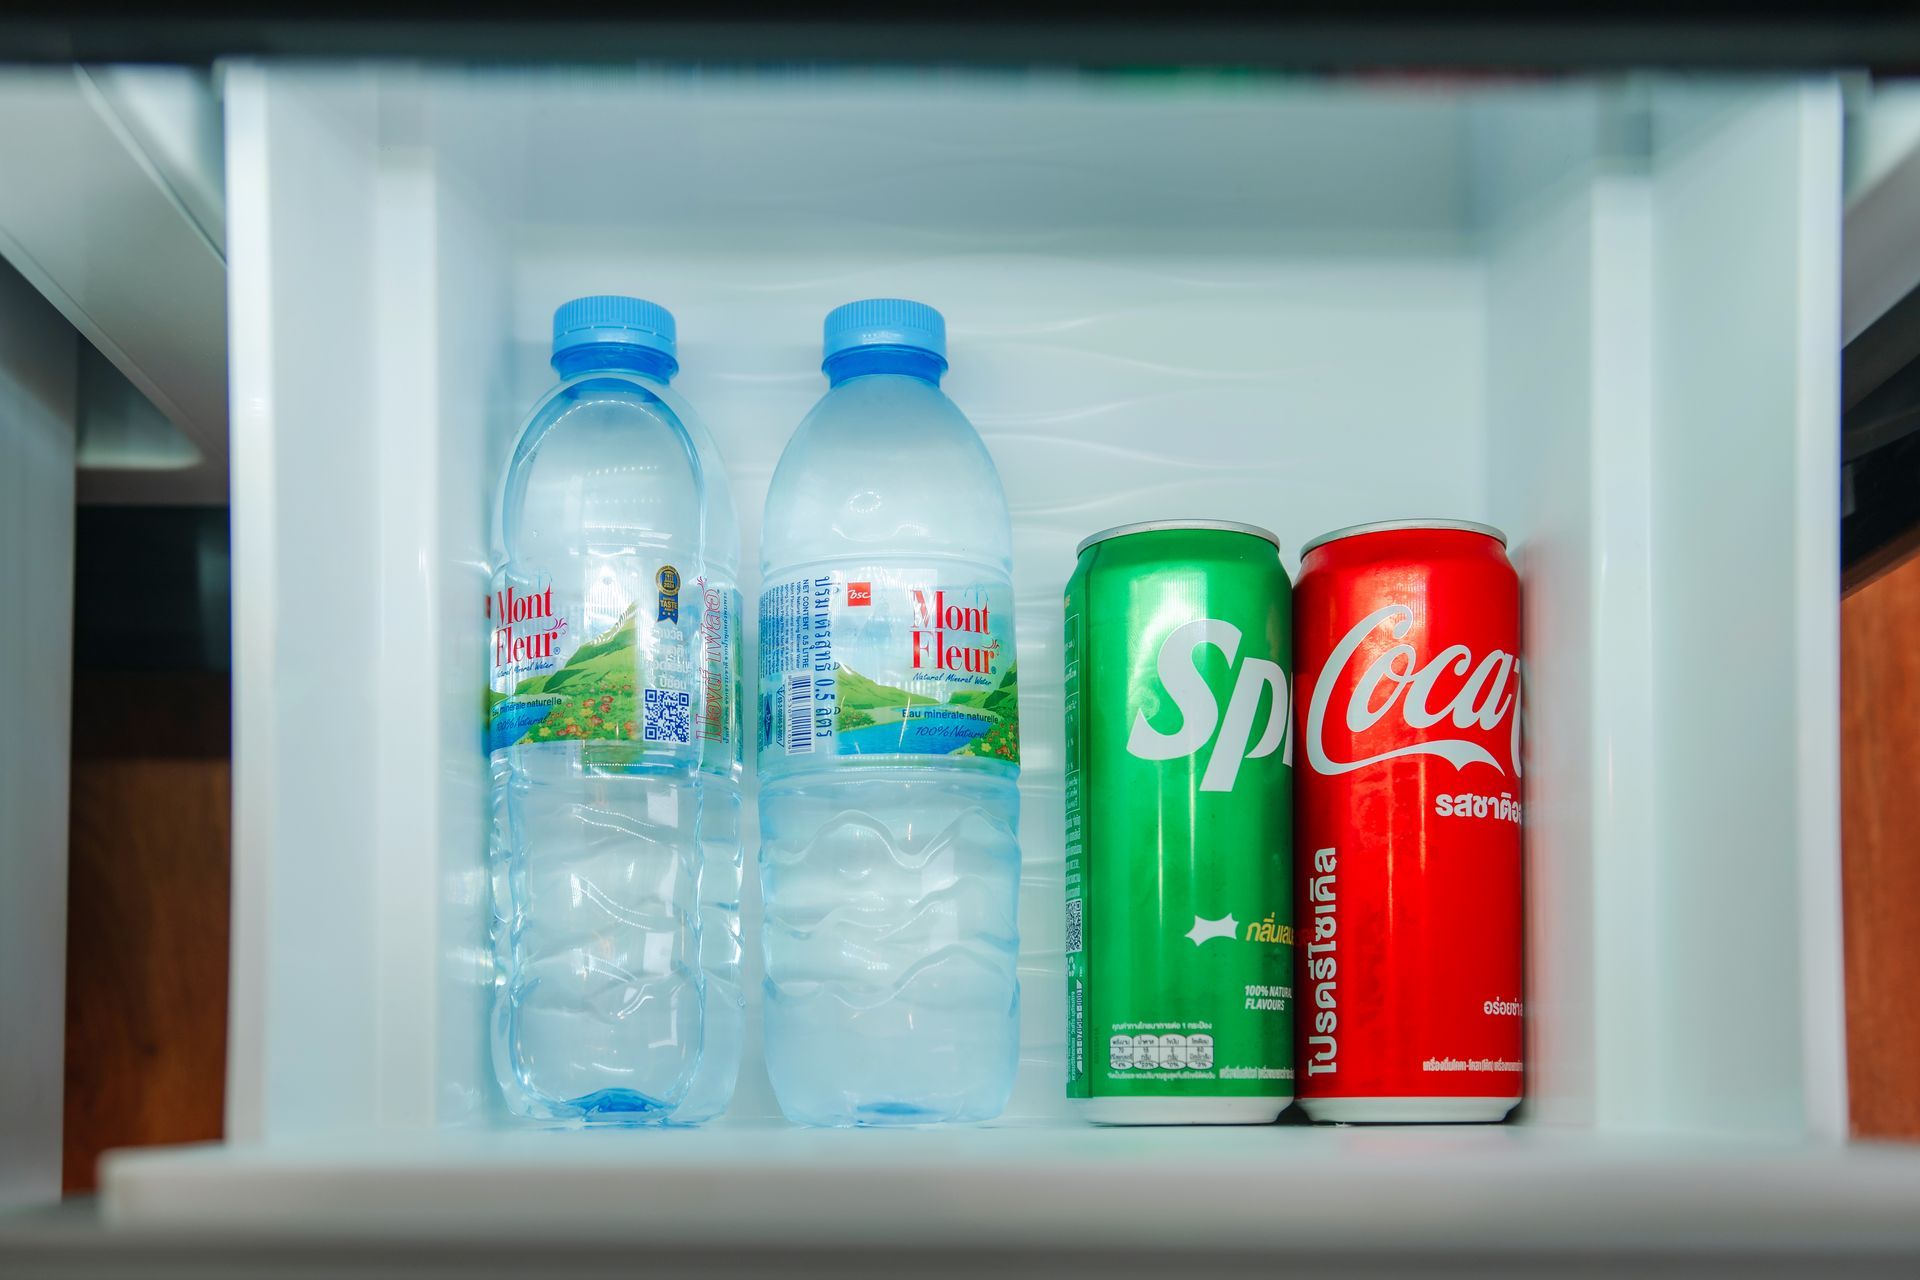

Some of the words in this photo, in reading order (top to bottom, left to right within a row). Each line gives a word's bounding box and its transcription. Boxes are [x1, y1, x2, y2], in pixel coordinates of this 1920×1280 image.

[849, 588, 869, 600] bsc
[497, 583, 553, 628] Mont
[911, 590, 991, 635] Mont
[495, 626, 558, 668] Fleur
[911, 631, 995, 675] Fleur
[912, 671, 945, 681] Natural
[945, 673, 974, 684] Mineral
[974, 676, 993, 687] Water
[815, 678, 836, 700] 0.5
[526, 697, 562, 708] naturelle
[815, 706, 841, 737] ลิตร
[902, 708, 921, 718] Eau
[924, 708, 965, 720] minérale
[966, 713, 999, 724] naturelle
[915, 726, 949, 737] 100%
[949, 724, 991, 738] Natural
[1308, 847, 1338, 1077] โปรดรีไซเคิล
[1245, 985, 1268, 996] 100%
[1245, 998, 1285, 1011] FLAVOURS
